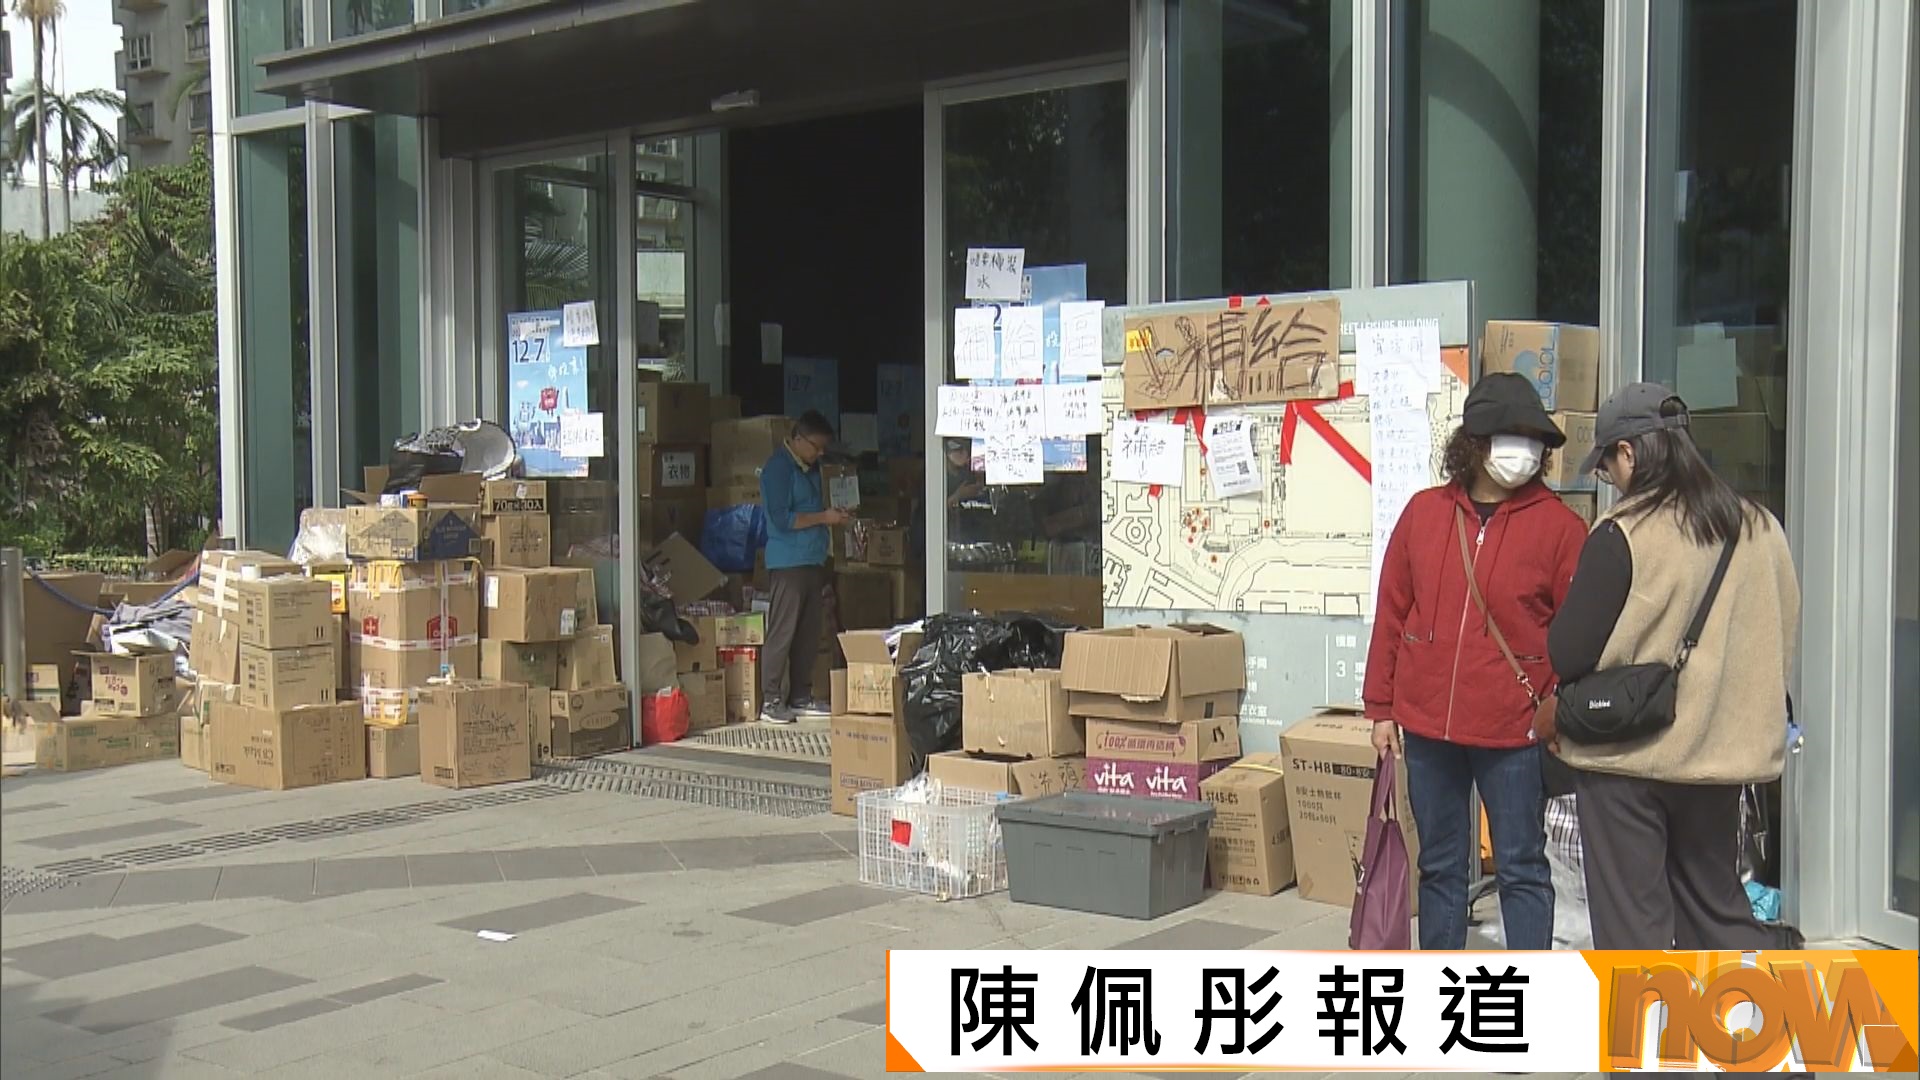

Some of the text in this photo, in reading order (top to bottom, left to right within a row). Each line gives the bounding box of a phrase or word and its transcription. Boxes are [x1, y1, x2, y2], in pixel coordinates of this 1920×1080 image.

[1335, 660, 1347, 678] 3
[1094, 761, 1188, 793] vita vita
